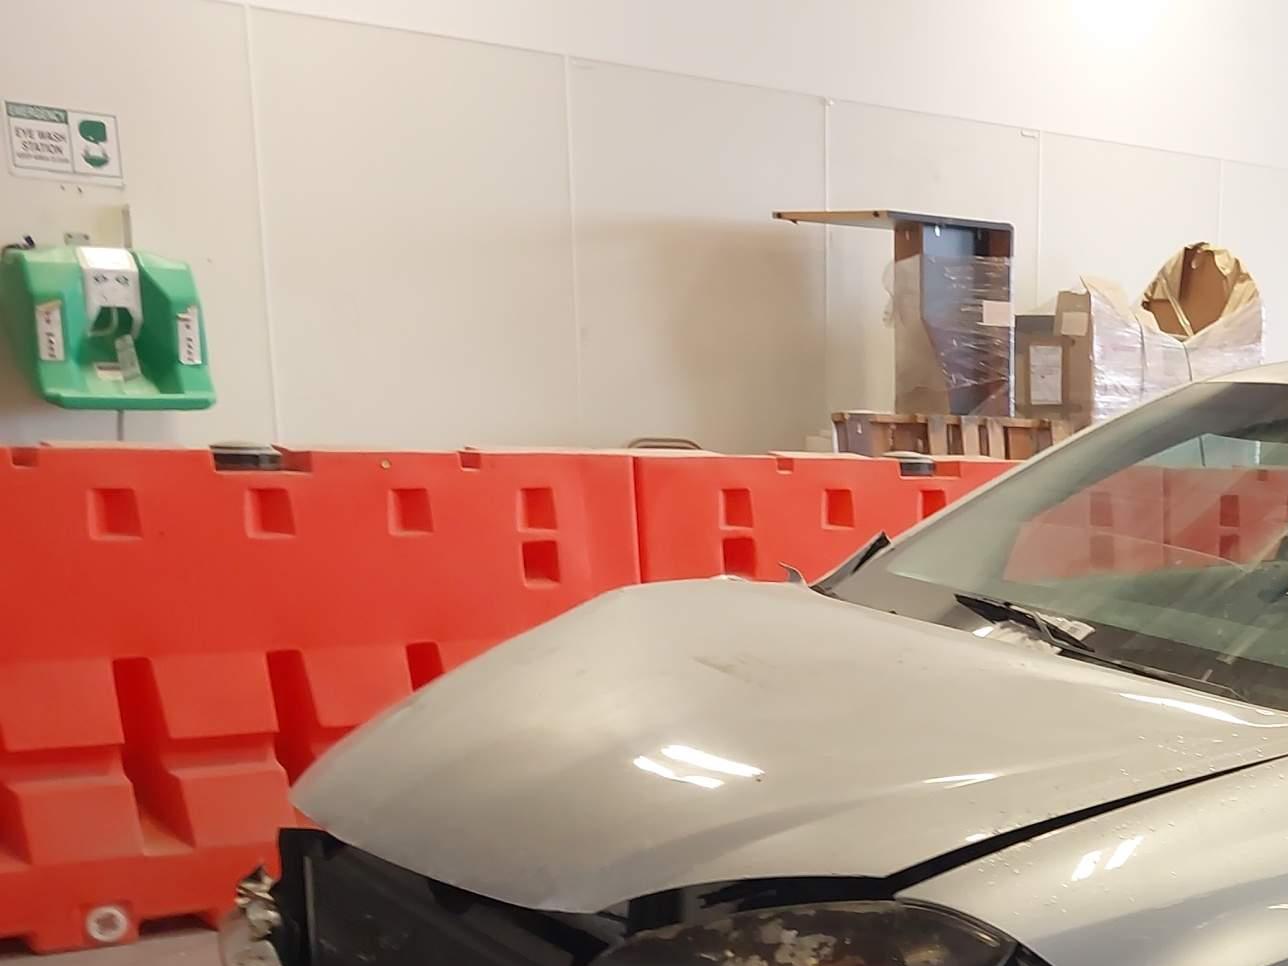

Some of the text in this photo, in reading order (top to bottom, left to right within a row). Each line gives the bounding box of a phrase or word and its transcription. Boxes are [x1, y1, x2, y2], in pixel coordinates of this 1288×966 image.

[15, 126, 67, 144] EYE WASH
[21, 141, 63, 155] STATION
